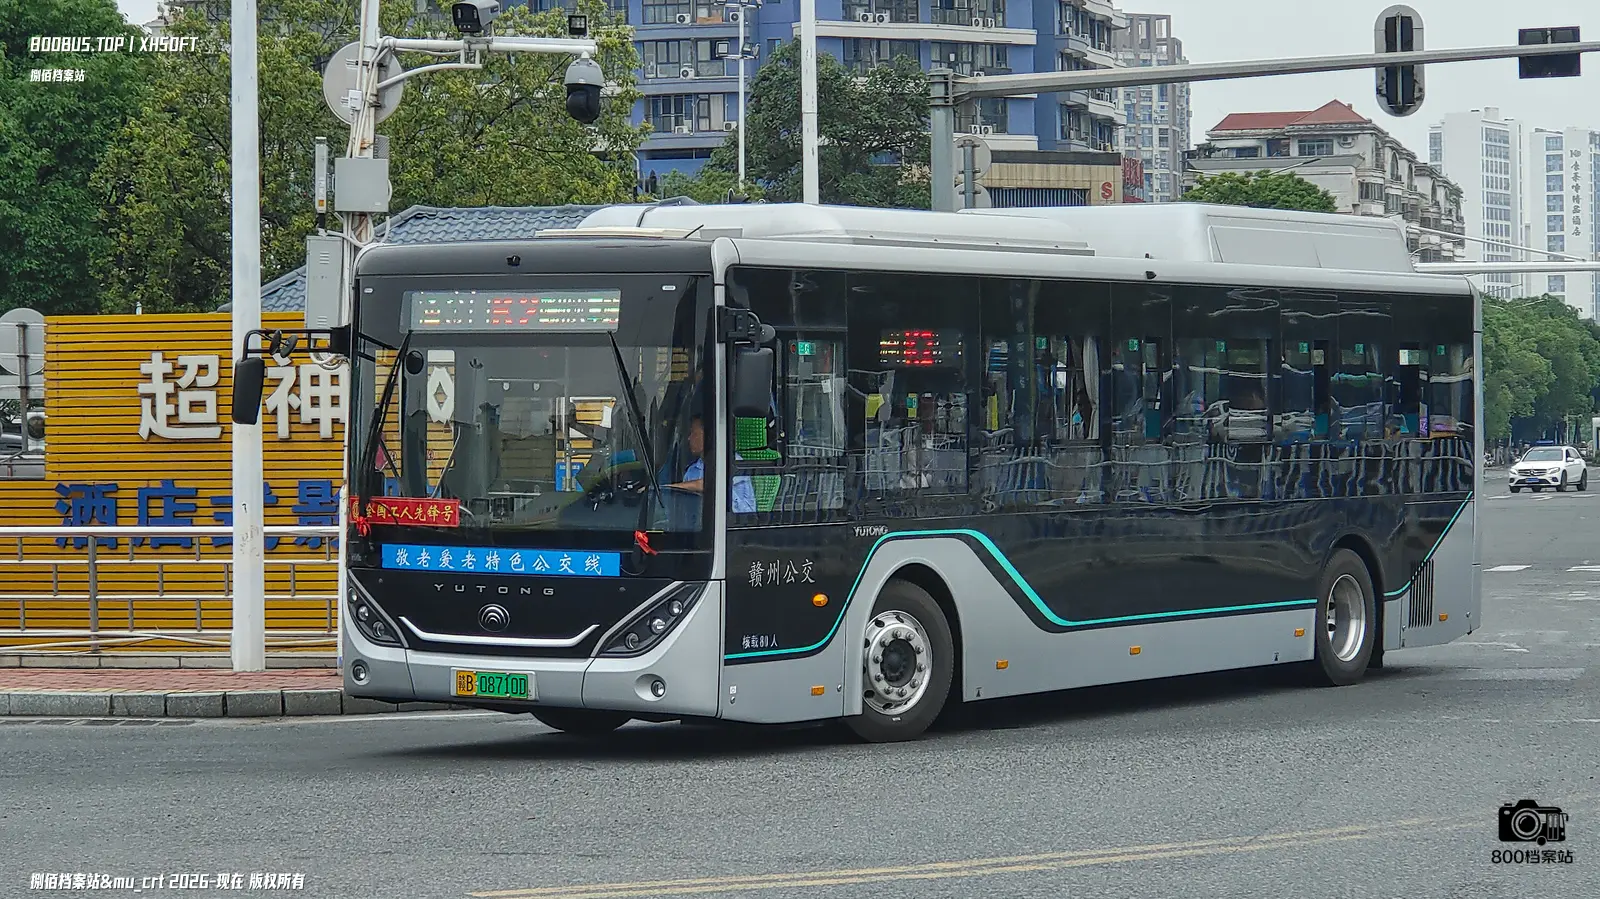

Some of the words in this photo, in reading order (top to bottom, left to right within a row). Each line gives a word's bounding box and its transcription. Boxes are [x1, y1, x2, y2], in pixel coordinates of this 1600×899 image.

[853, 526, 889, 537] YUTONG
[395, 548, 602, 575] 敬老爱老特色公交线
[748, 559, 816, 587] 赣州公交
[434, 583, 555, 596] YUTONG
